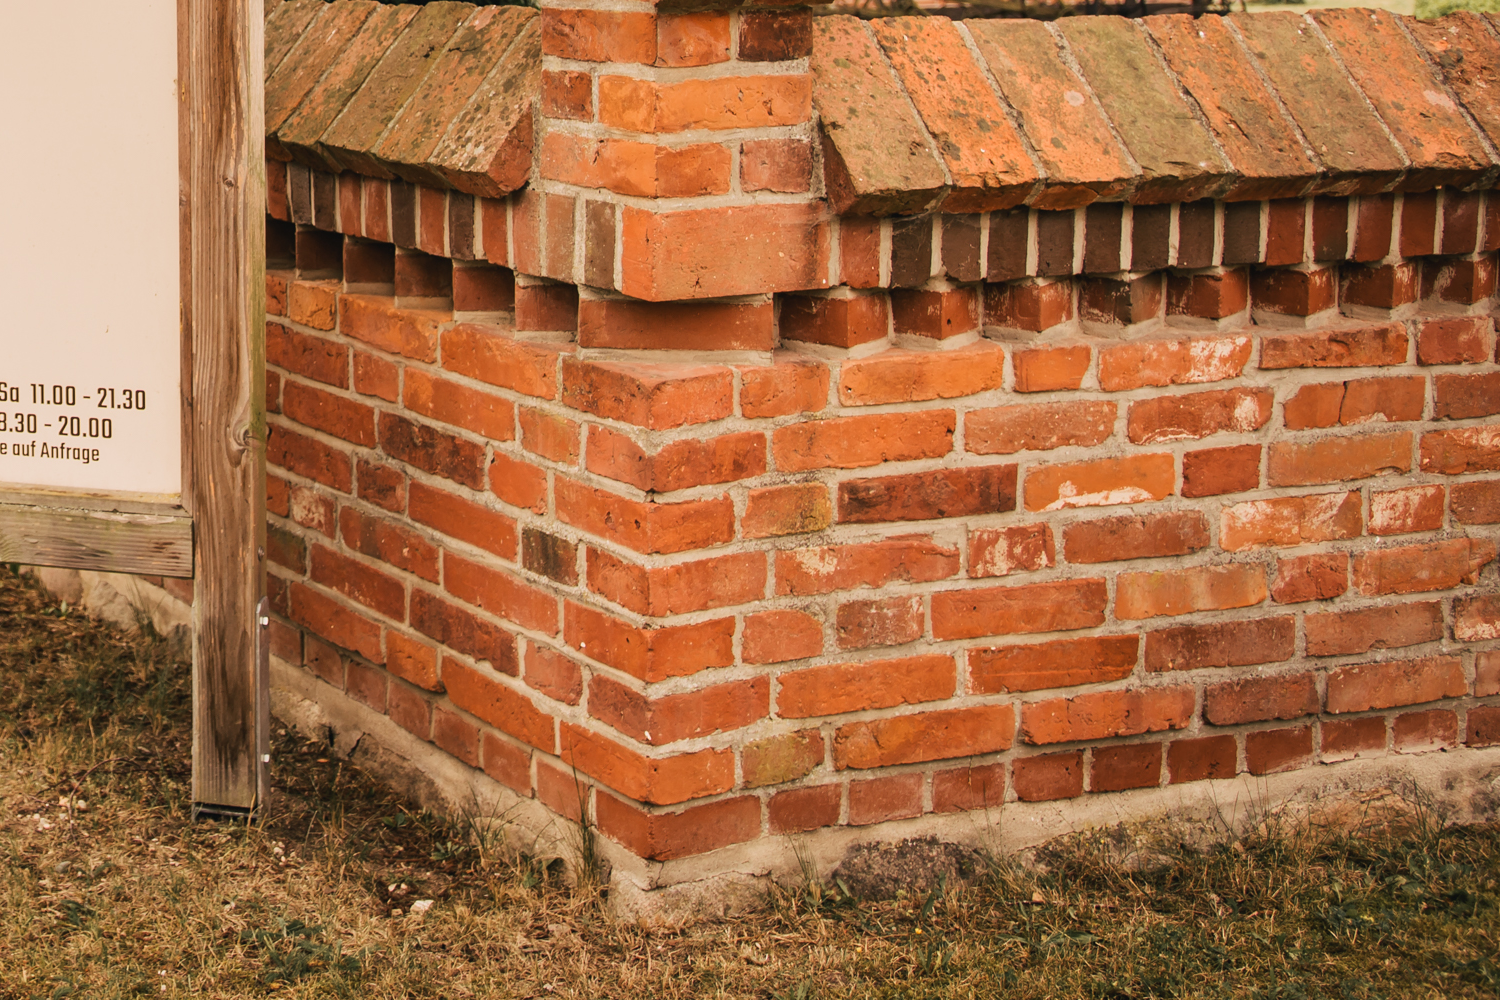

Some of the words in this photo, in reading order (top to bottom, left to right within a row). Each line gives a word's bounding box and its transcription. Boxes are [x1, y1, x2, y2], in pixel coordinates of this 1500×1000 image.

[30, 383, 76, 406] 11.00
[97, 387, 146, 411] 21.30
[58, 415, 113, 439] 20.00
[12, 440, 37, 457] auf
[40, 442, 100, 465] Anfrage
